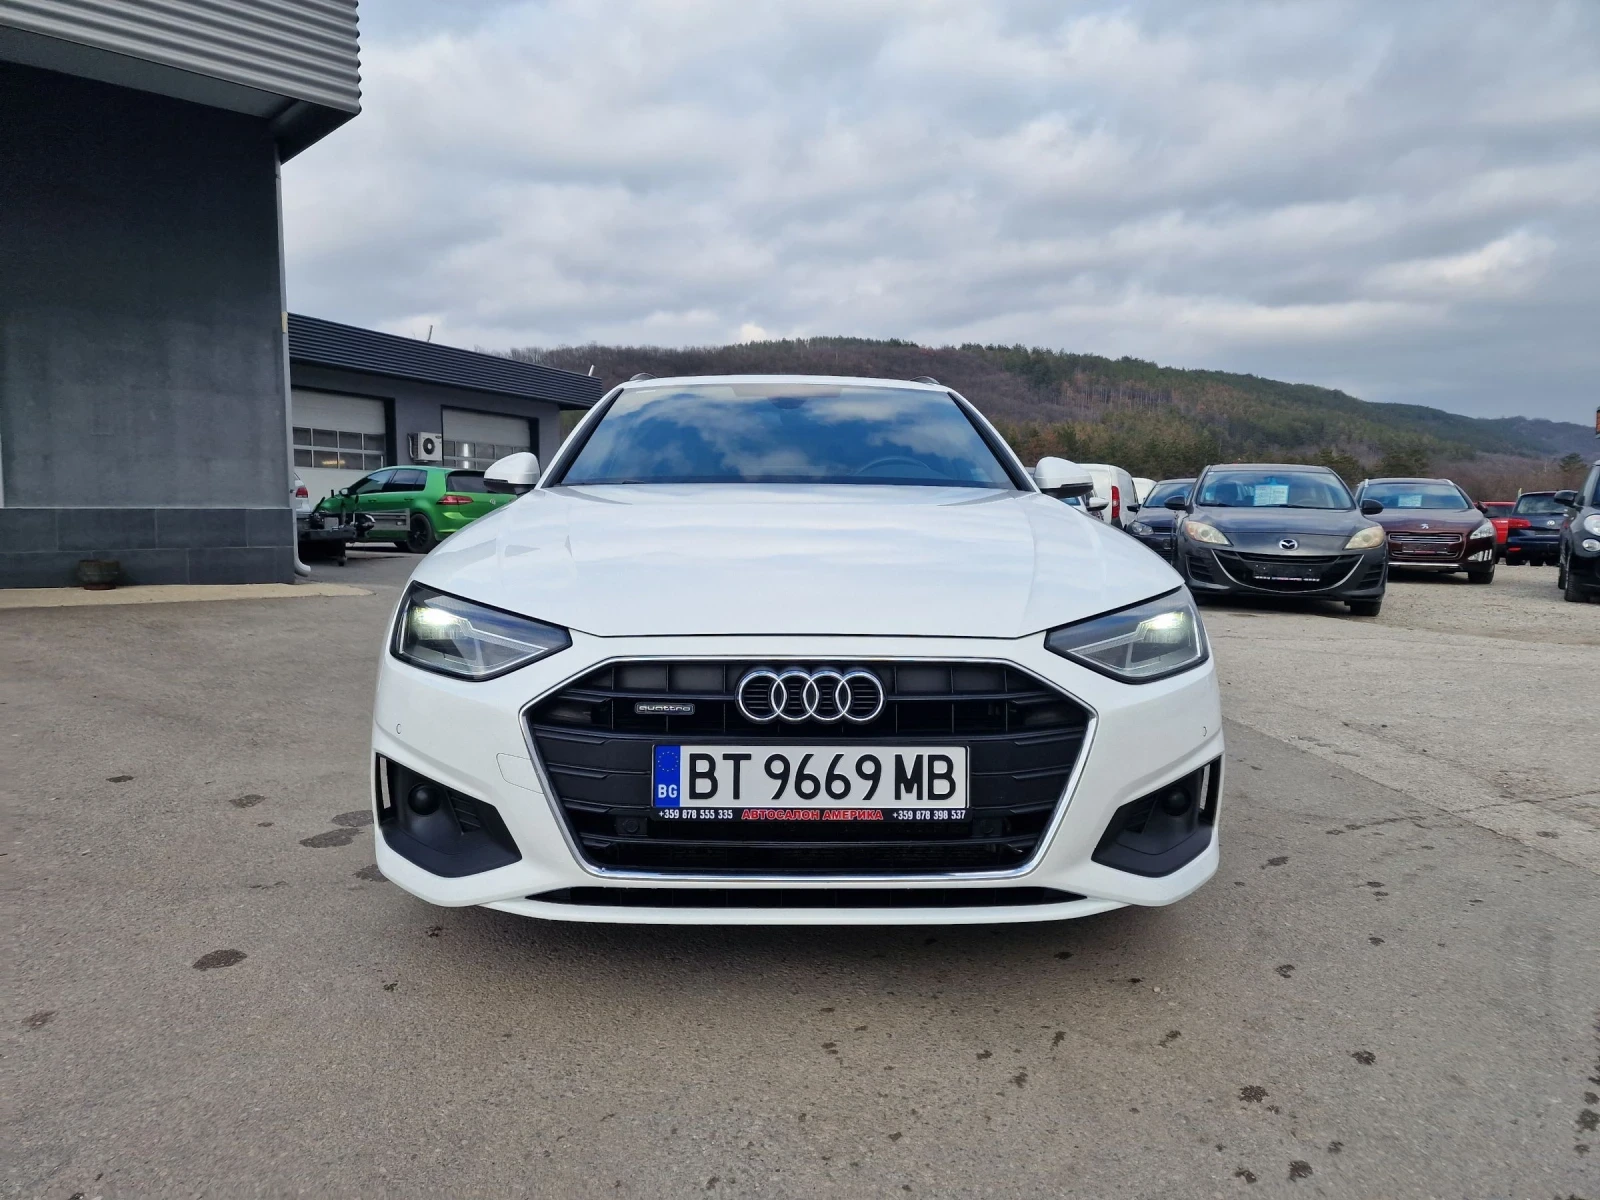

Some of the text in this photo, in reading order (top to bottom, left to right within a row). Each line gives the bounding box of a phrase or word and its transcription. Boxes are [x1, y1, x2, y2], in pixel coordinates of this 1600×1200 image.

[638, 704, 691, 712] quattro
[688, 753, 956, 800] BT 9669 MB
[657, 784, 678, 798] BG
[658, 809, 733, 819] +359 878 555 335
[741, 809, 884, 820] АВТОСАЛОН АМЕРИКА
[892, 810, 966, 820] +359 878 398 537
